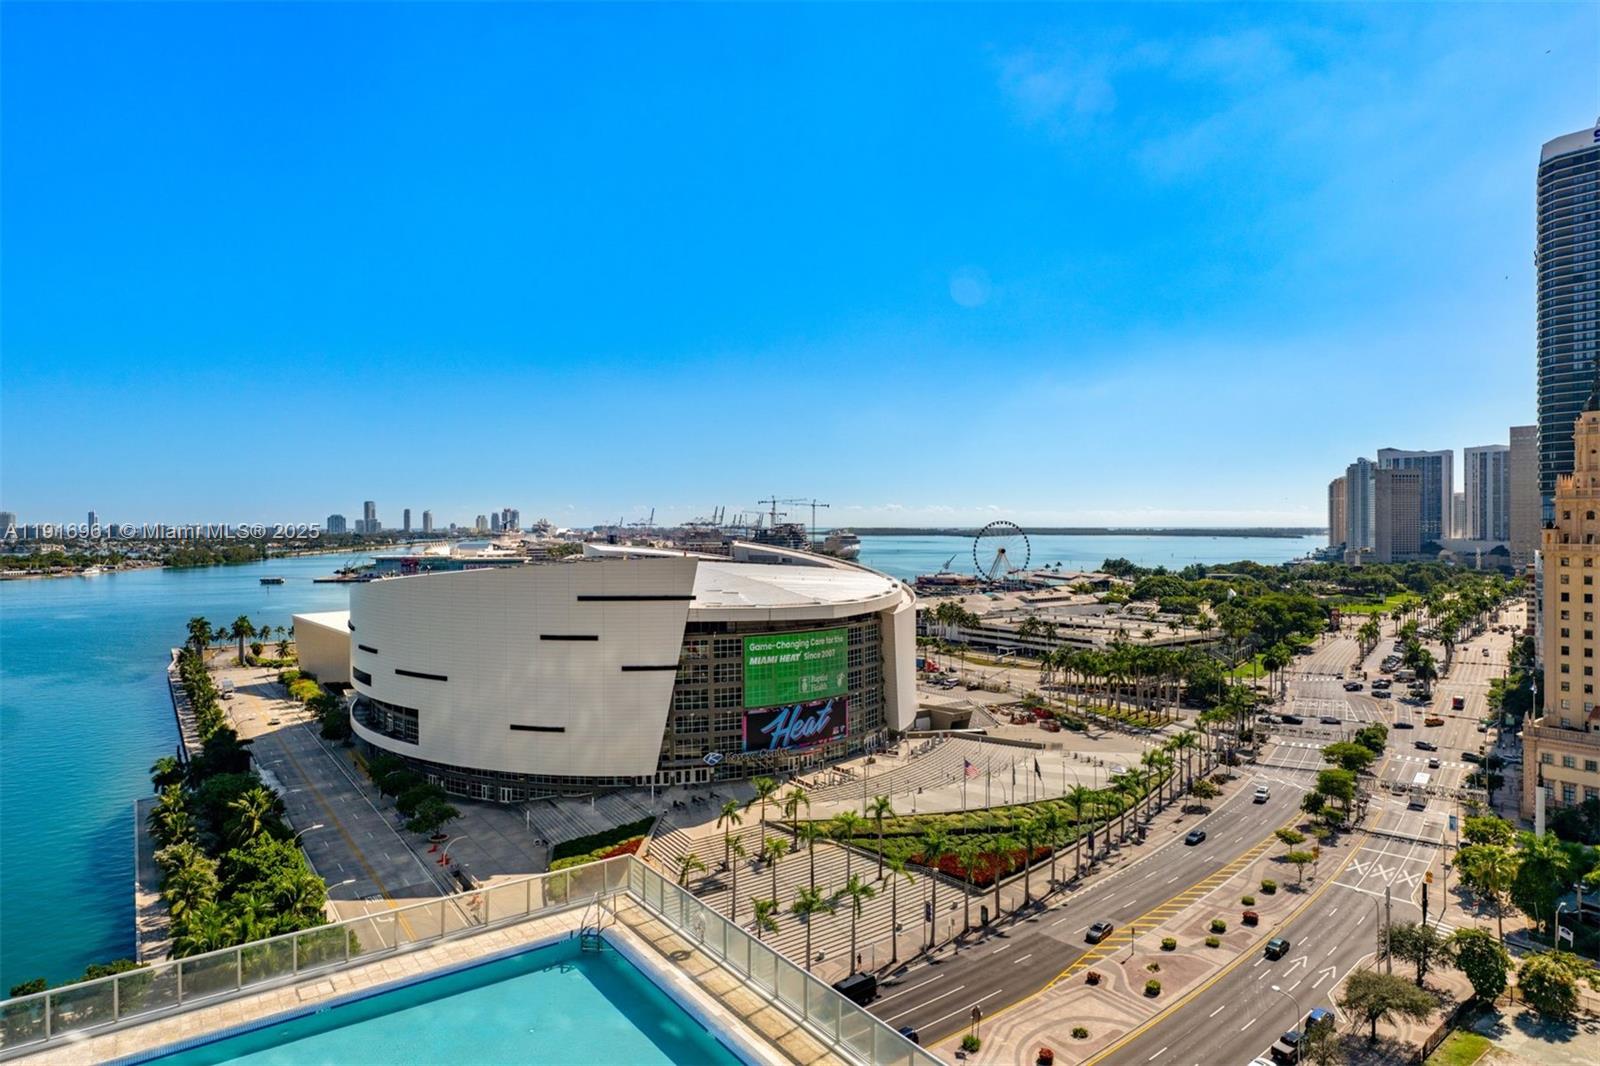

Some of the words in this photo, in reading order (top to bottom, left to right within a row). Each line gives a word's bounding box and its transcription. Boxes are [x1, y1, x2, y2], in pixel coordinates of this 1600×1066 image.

[749, 640, 809, 652] Game-Changing
[810, 638, 825, 646] Care
[749, 655, 778, 665] MIAMI
[779, 652, 802, 663] HEAT
[804, 651, 821, 660] Since
[760, 698, 833, 749] Heat
